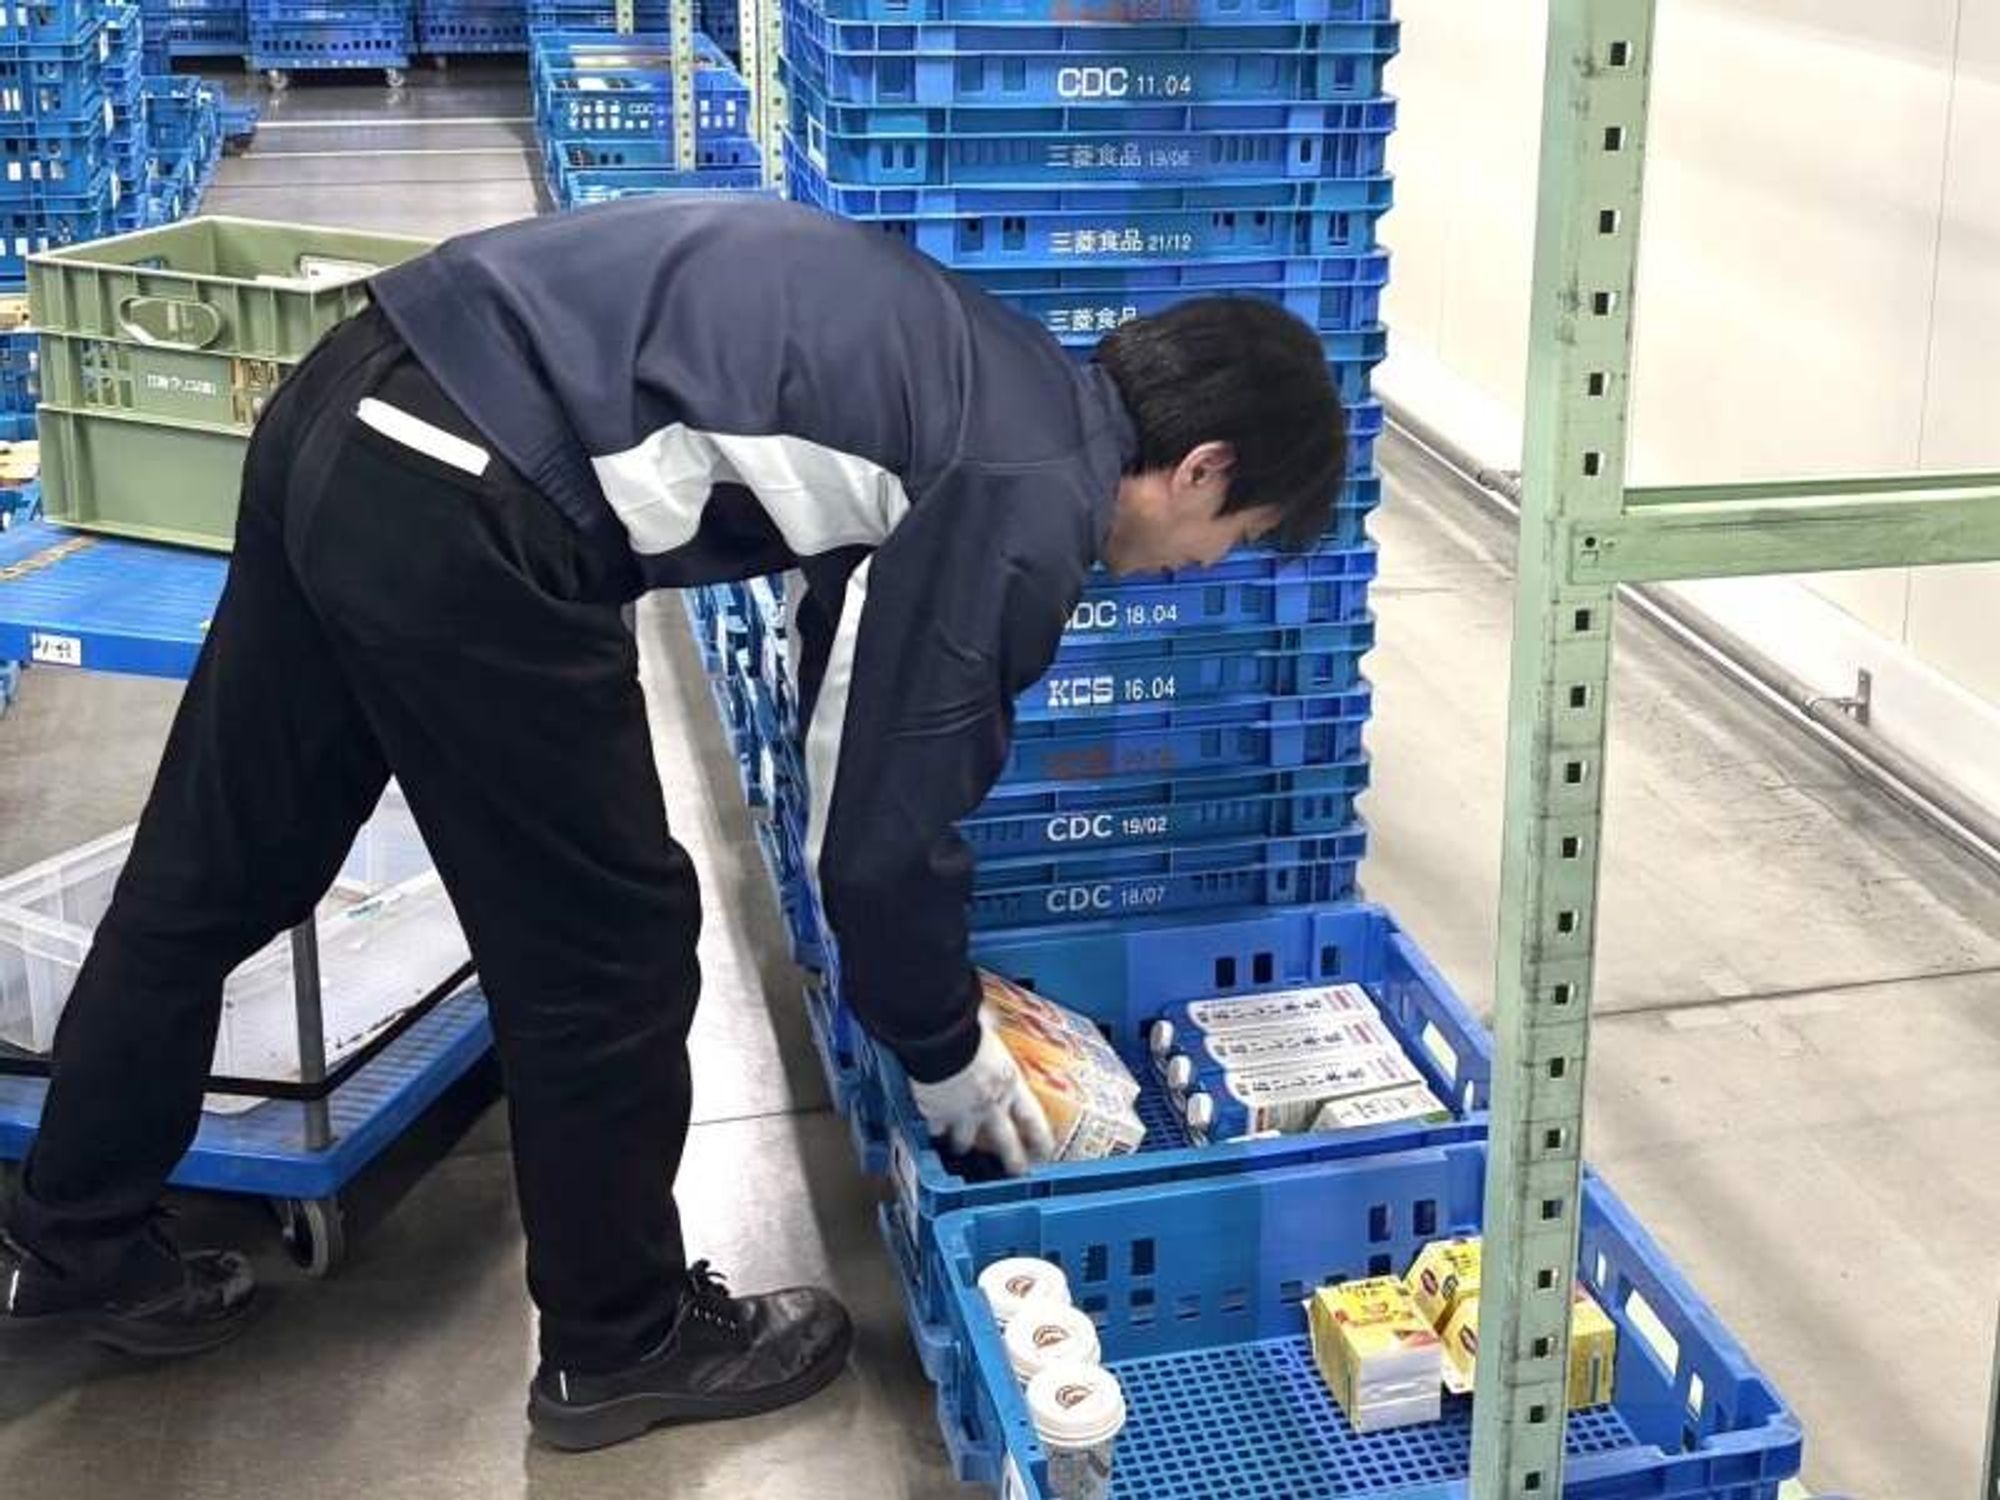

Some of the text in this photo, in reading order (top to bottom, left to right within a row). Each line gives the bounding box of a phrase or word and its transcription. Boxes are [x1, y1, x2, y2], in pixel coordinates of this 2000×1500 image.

[1057, 67, 1191, 97] CDC 11.04
[1045, 143, 1142, 168] 三菱食品
[1048, 228, 1192, 253] 三菱食品 21/12
[1064, 600, 1177, 629] DC 18.04
[1047, 675, 1177, 706] KCS 16.04
[1047, 815, 1167, 841] CDC 19/02
[1047, 885, 1112, 911] CDC
